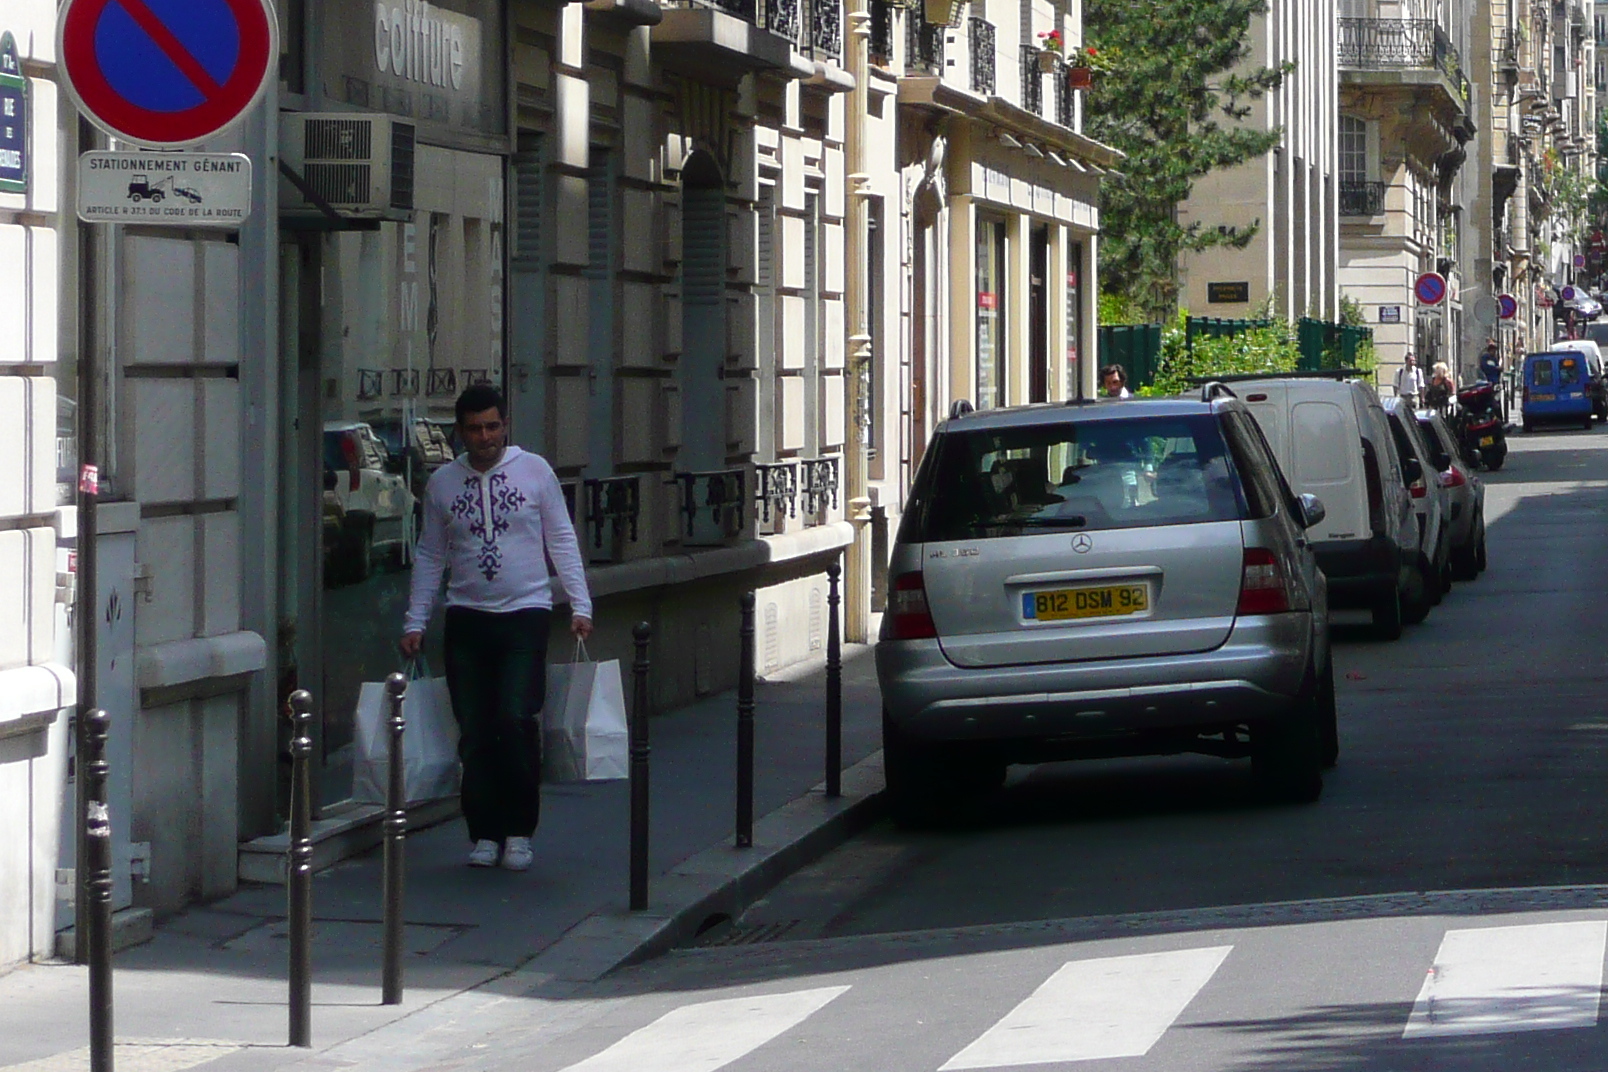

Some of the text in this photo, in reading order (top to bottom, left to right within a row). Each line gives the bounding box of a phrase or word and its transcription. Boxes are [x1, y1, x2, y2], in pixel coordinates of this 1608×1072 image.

[90, 158, 241, 172] STATIONNEMENT GÊNANT
[86, 206, 119, 215] ARTICLE
[164, 208, 185, 216] CODE
[189, 208, 199, 216] DE
[203, 208, 212, 216] LA
[216, 209, 242, 217] ROUTE
[1037, 588, 1144, 613] 812 DSM 92
